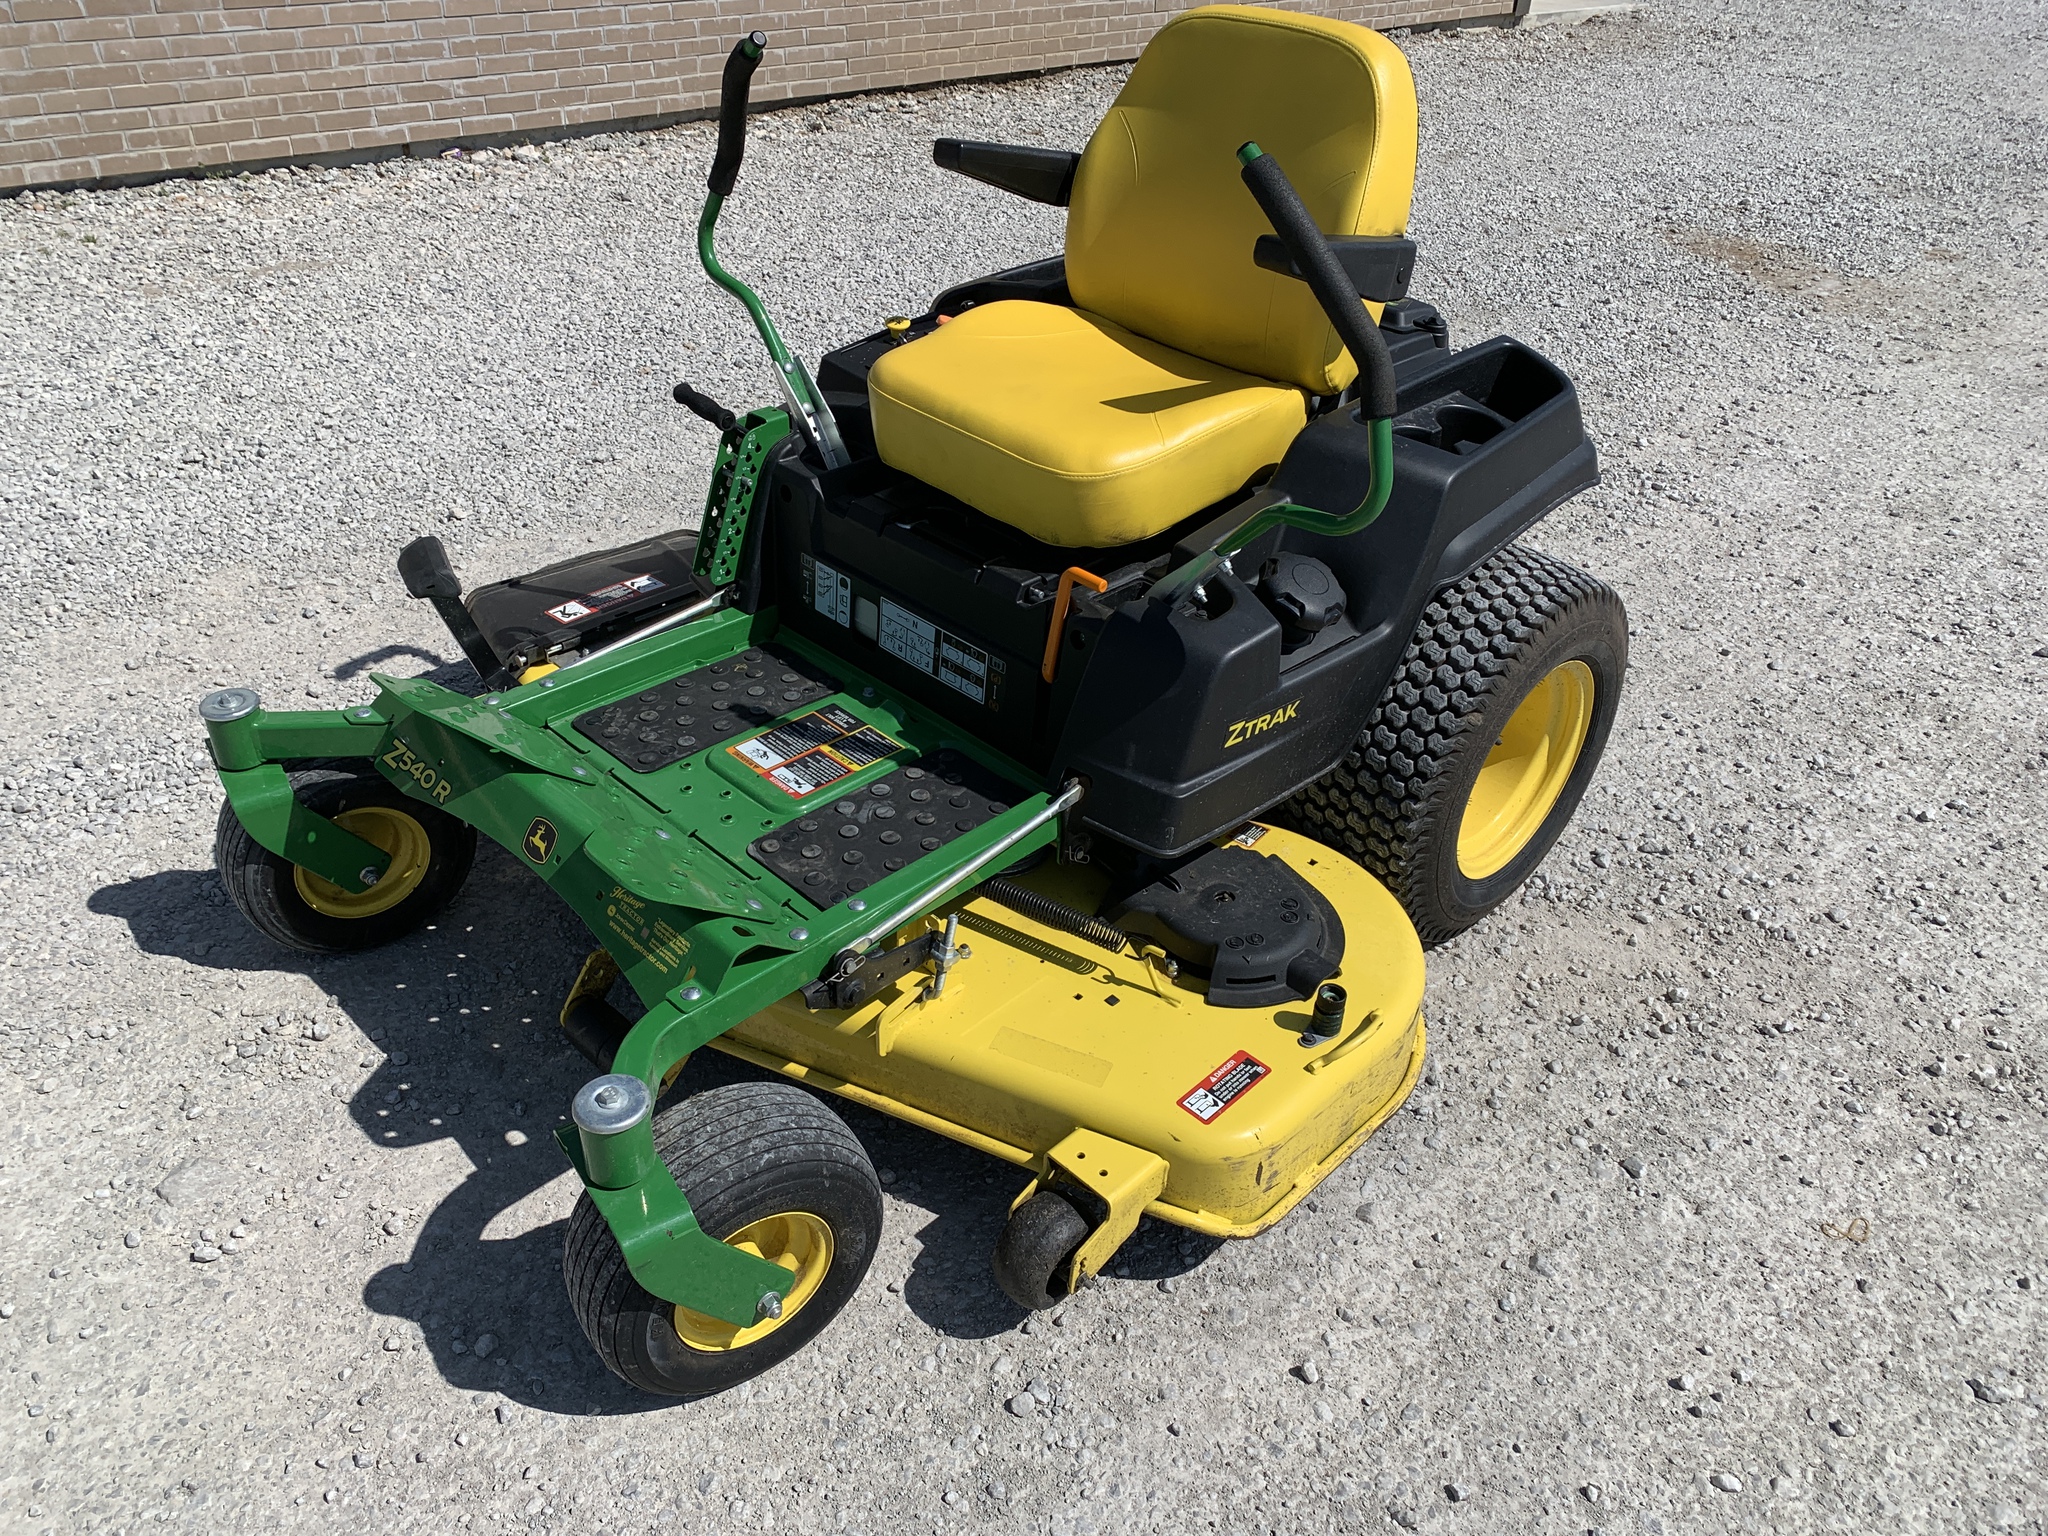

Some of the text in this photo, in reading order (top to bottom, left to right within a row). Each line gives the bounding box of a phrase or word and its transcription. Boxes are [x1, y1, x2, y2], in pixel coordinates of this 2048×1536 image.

[1224, 700, 1300, 748] ZTRAK
[382, 738, 452, 804] Z540 R
[610, 886, 646, 909] Heritage
[619, 902, 645, 926] TRACTOR
[609, 920, 668, 974] www.heritagetractor.com
[1212, 1063, 1246, 1091] ROTATING BLADE
[1214, 1059, 1236, 1078] DANGER
